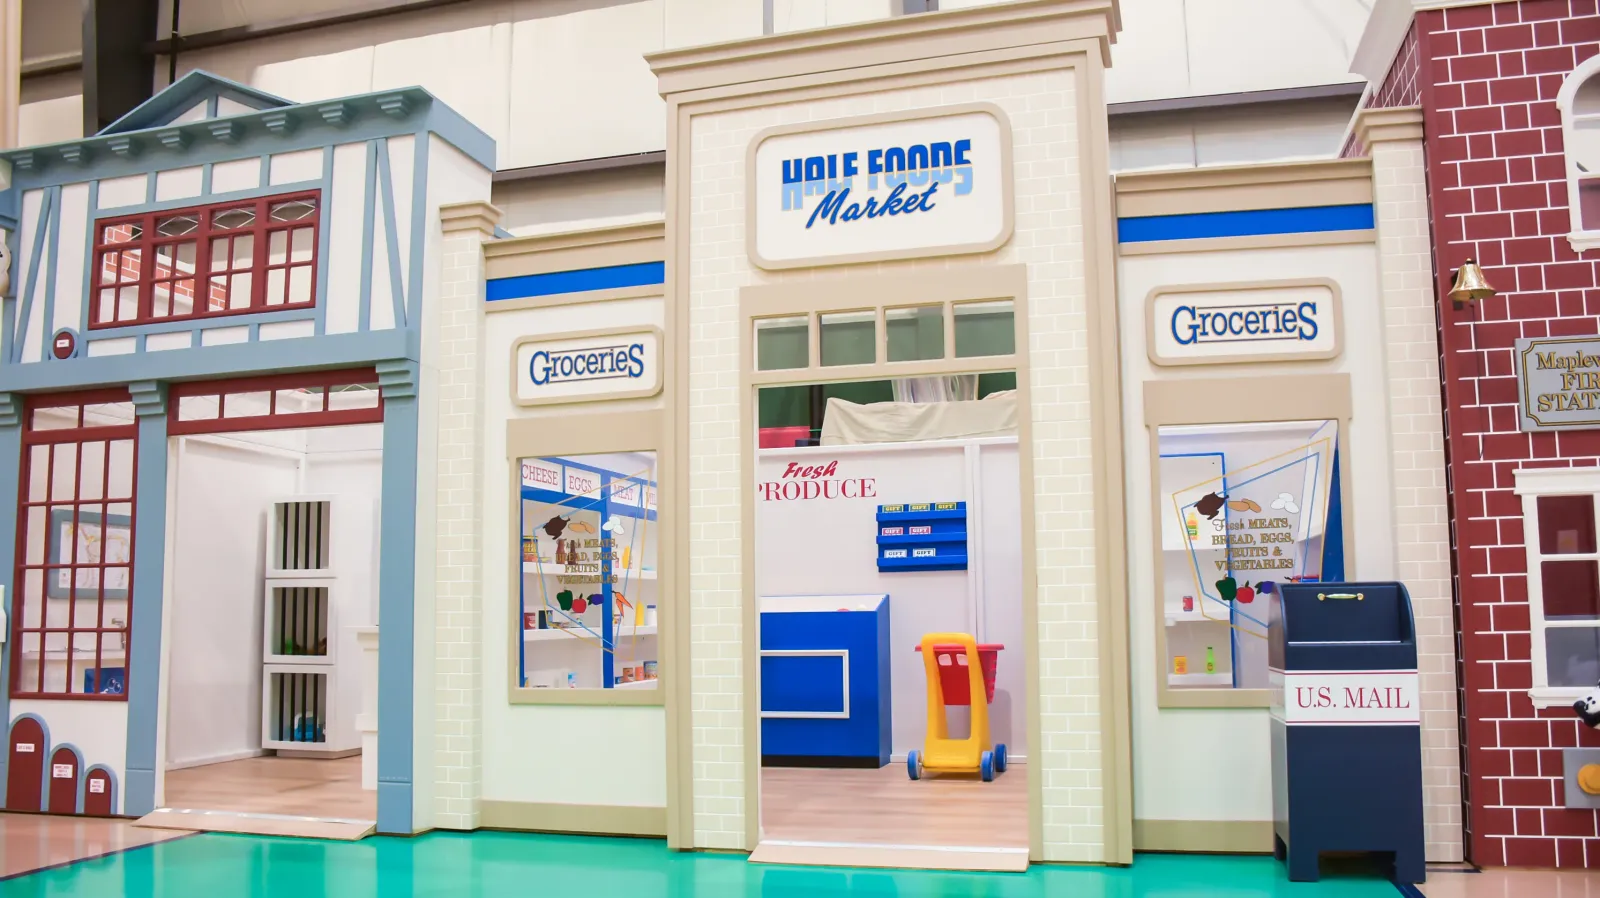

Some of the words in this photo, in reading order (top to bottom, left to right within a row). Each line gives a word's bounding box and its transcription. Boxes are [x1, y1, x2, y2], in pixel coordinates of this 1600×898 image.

[782, 151, 859, 211] HALF
[867, 139, 973, 197] FOODS
[805, 181, 939, 229] Market
[1560, 372, 1600, 391] FIR
[1537, 391, 1600, 412] STAT
[521, 464, 559, 486] CHEESE
[782, 460, 838, 480] Fresh
[568, 475, 592, 494] EGGS
[613, 484, 634, 501] MEAT
[758, 478, 877, 502] RODUCE
[1248, 517, 1292, 530] MEATS,
[1211, 533, 1257, 546] BREAD,
[1260, 532, 1295, 545] EGGS,
[1224, 547, 1269, 558] FRUITS
[1272, 546, 1283, 557] &
[564, 563, 599, 573] FRUITS
[602, 564, 610, 573] &
[1214, 558, 1294, 571] VEGETABLES
[1295, 686, 1337, 708] U.S.
[1343, 687, 1410, 708] MAIL
